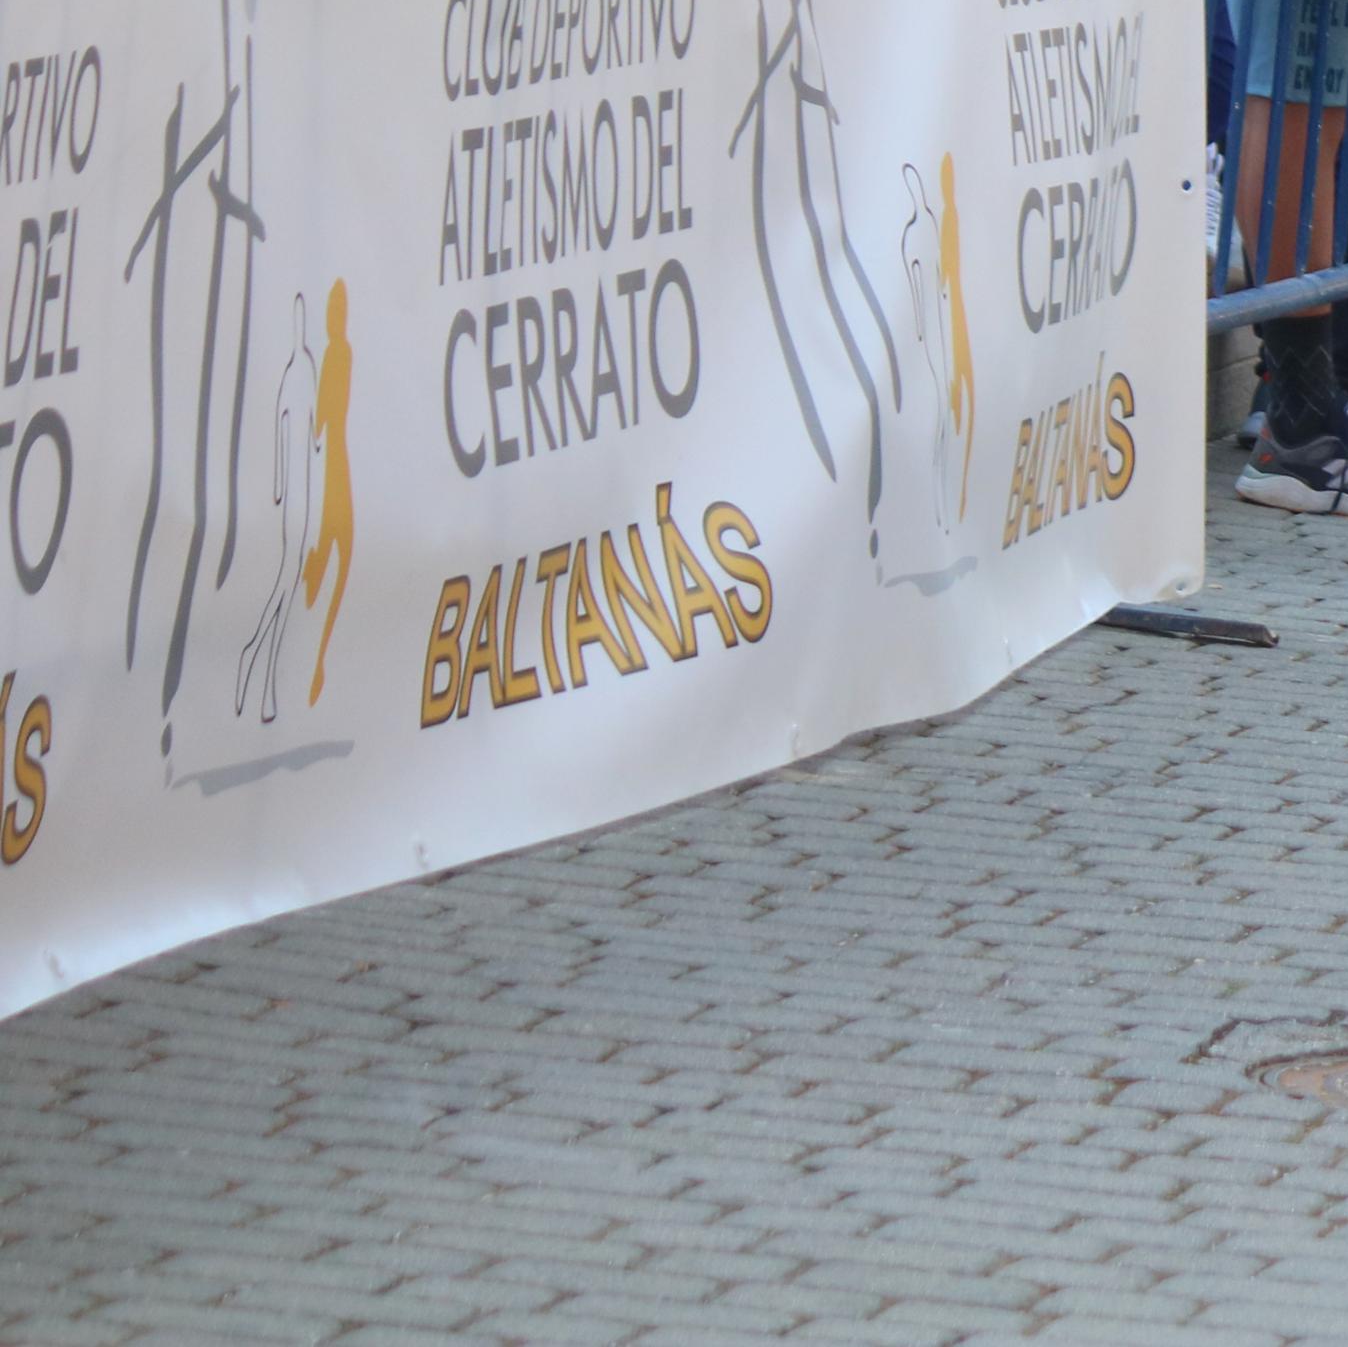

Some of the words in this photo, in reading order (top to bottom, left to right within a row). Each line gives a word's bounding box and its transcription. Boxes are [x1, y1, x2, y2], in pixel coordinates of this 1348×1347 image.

[440, 98, 619, 286] ATLETISMO
[632, 88, 693, 240] DEL
[3, 207, 81, 388] DEL
[444, 258, 700, 478] CERRATO
[420, 482, 773, 729] BALTANÁS
